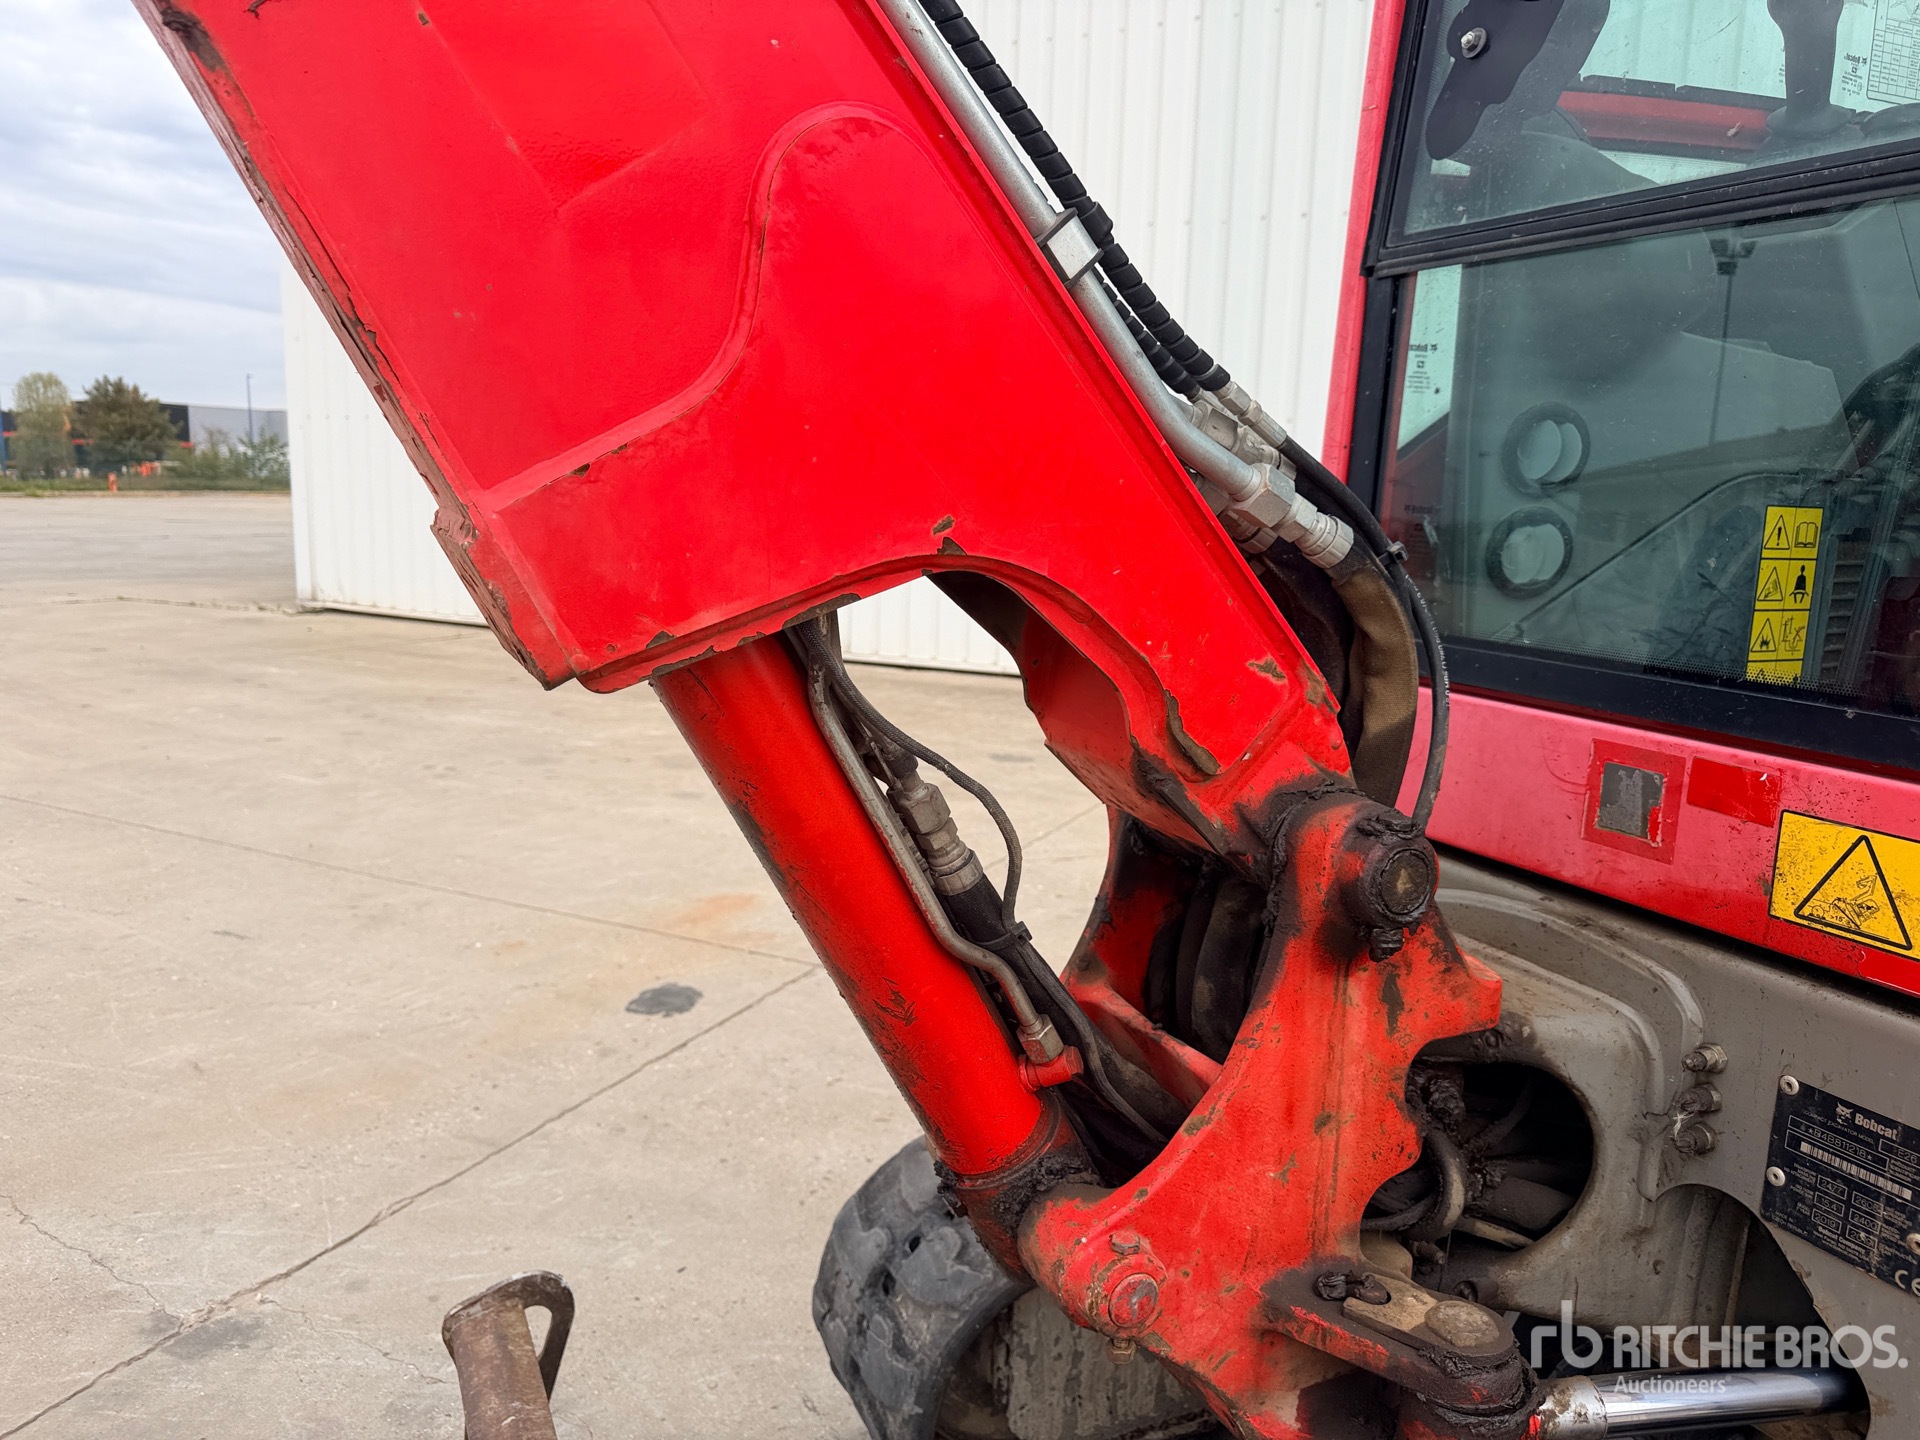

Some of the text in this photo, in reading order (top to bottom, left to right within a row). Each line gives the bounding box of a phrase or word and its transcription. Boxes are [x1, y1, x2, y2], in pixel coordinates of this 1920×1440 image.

[1855, 1112, 1899, 1141] Bobcat
[1897, 1149, 1918, 1164] E26
[1815, 1212, 1836, 1229] 2019
[1854, 1214, 1878, 1231] 2400
